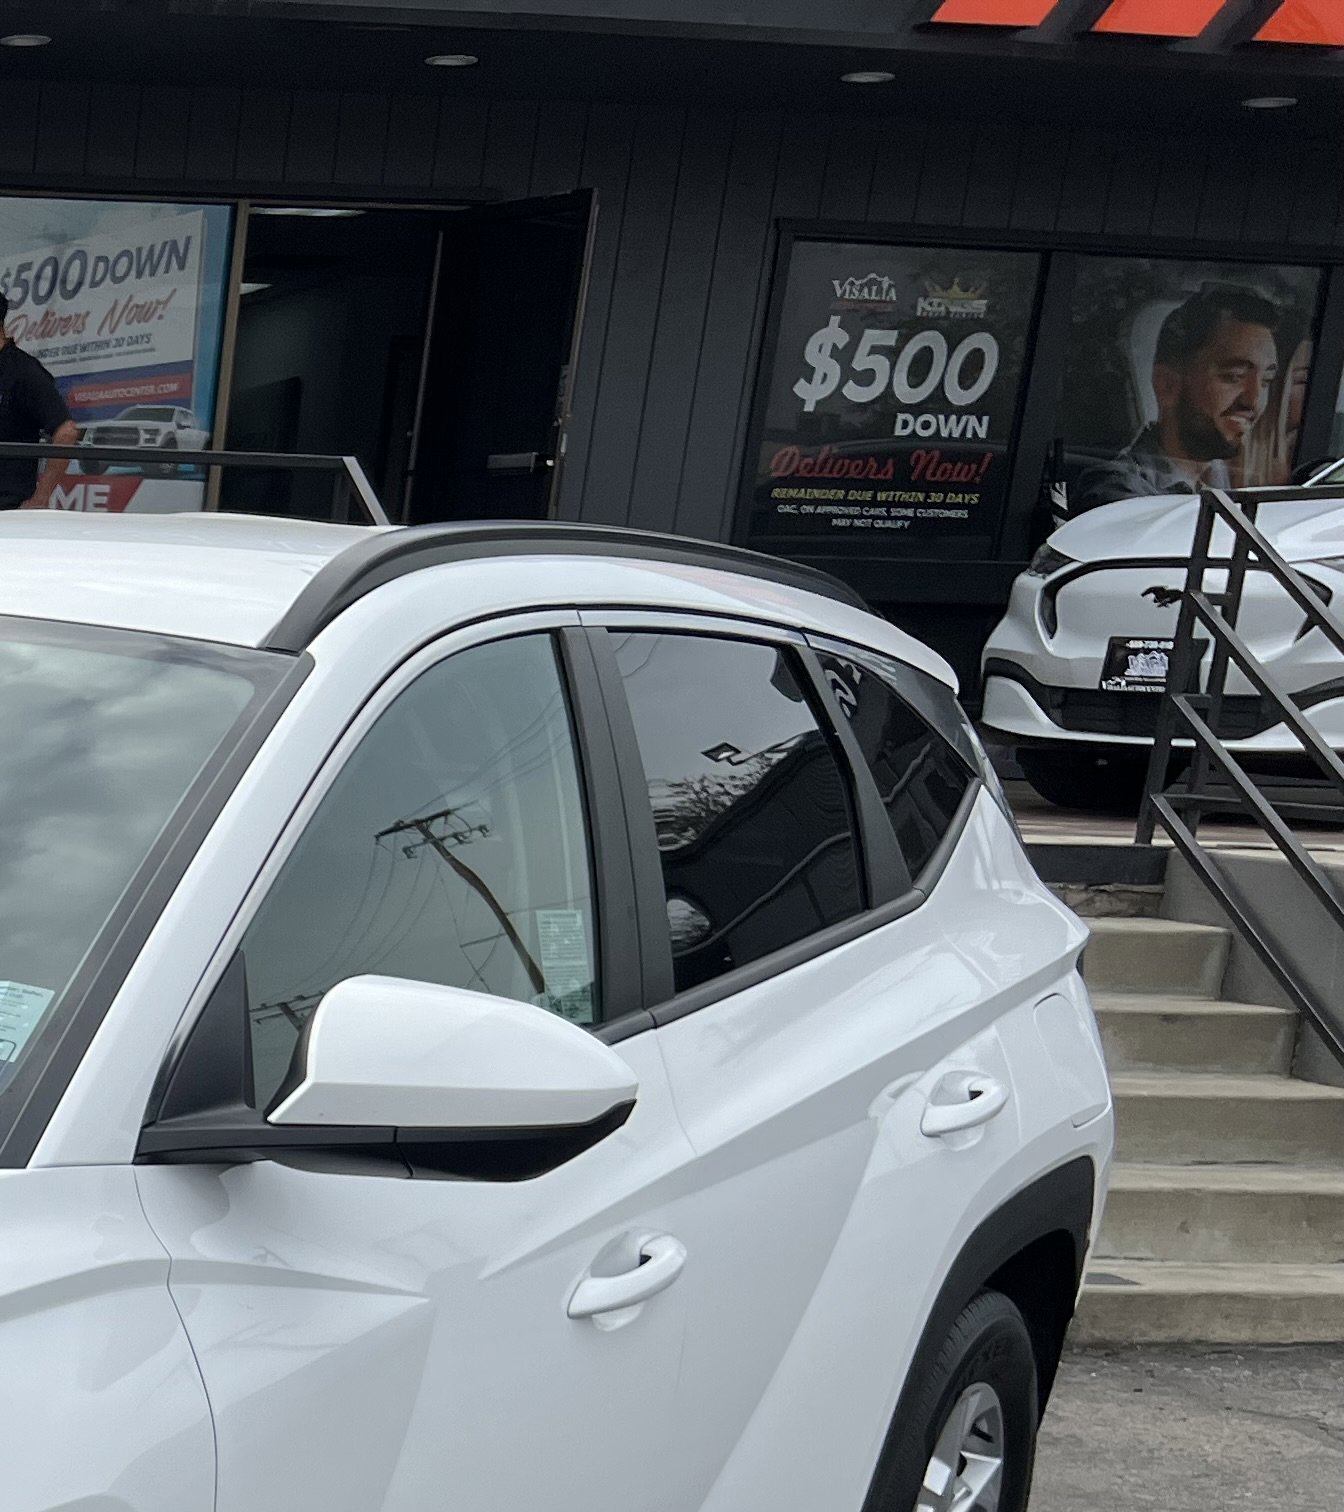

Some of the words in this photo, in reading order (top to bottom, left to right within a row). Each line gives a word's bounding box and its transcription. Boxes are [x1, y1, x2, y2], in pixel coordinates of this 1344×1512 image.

[89, 235, 193, 289] DOWN
[832, 273, 897, 301] VISALIA
[96, 287, 177, 337] Now!
[792, 314, 1000, 412] $500
[893, 411, 990, 439] DOWN
[769, 445, 897, 480] Delivers
[909, 447, 994, 484] Now!
[770, 486, 846, 501] REMAINDER
[846, 489, 873, 502] DUE
[876, 490, 926, 503] WITHIN
[926, 491, 943, 503] 30
[945, 491, 981, 505] DAYS
